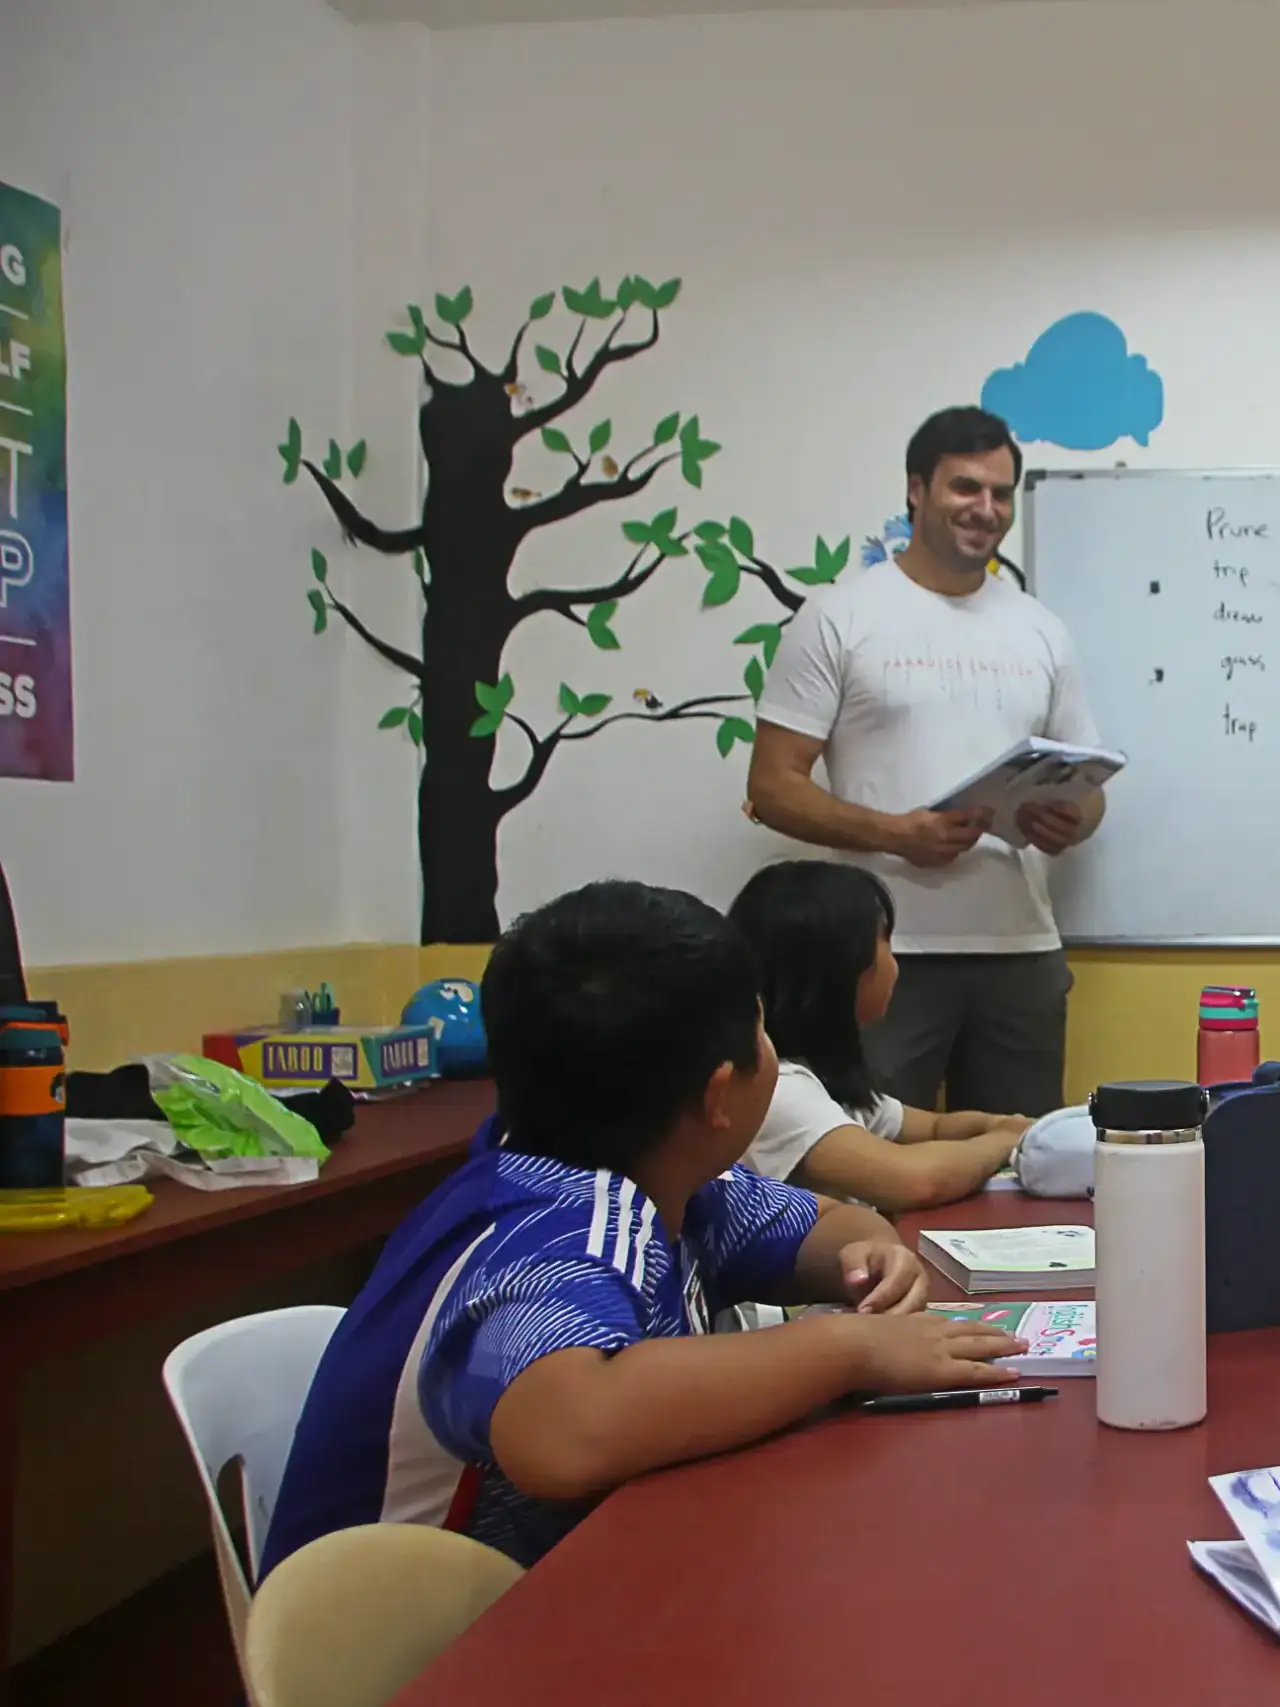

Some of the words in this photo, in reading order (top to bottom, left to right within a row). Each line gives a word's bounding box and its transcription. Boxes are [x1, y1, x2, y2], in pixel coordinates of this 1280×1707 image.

[1206, 505, 1269, 540] Prune
[1213, 559, 1249, 588] trip
[1222, 702, 1257, 743] trap
[267, 1045, 323, 1073] TABOO
